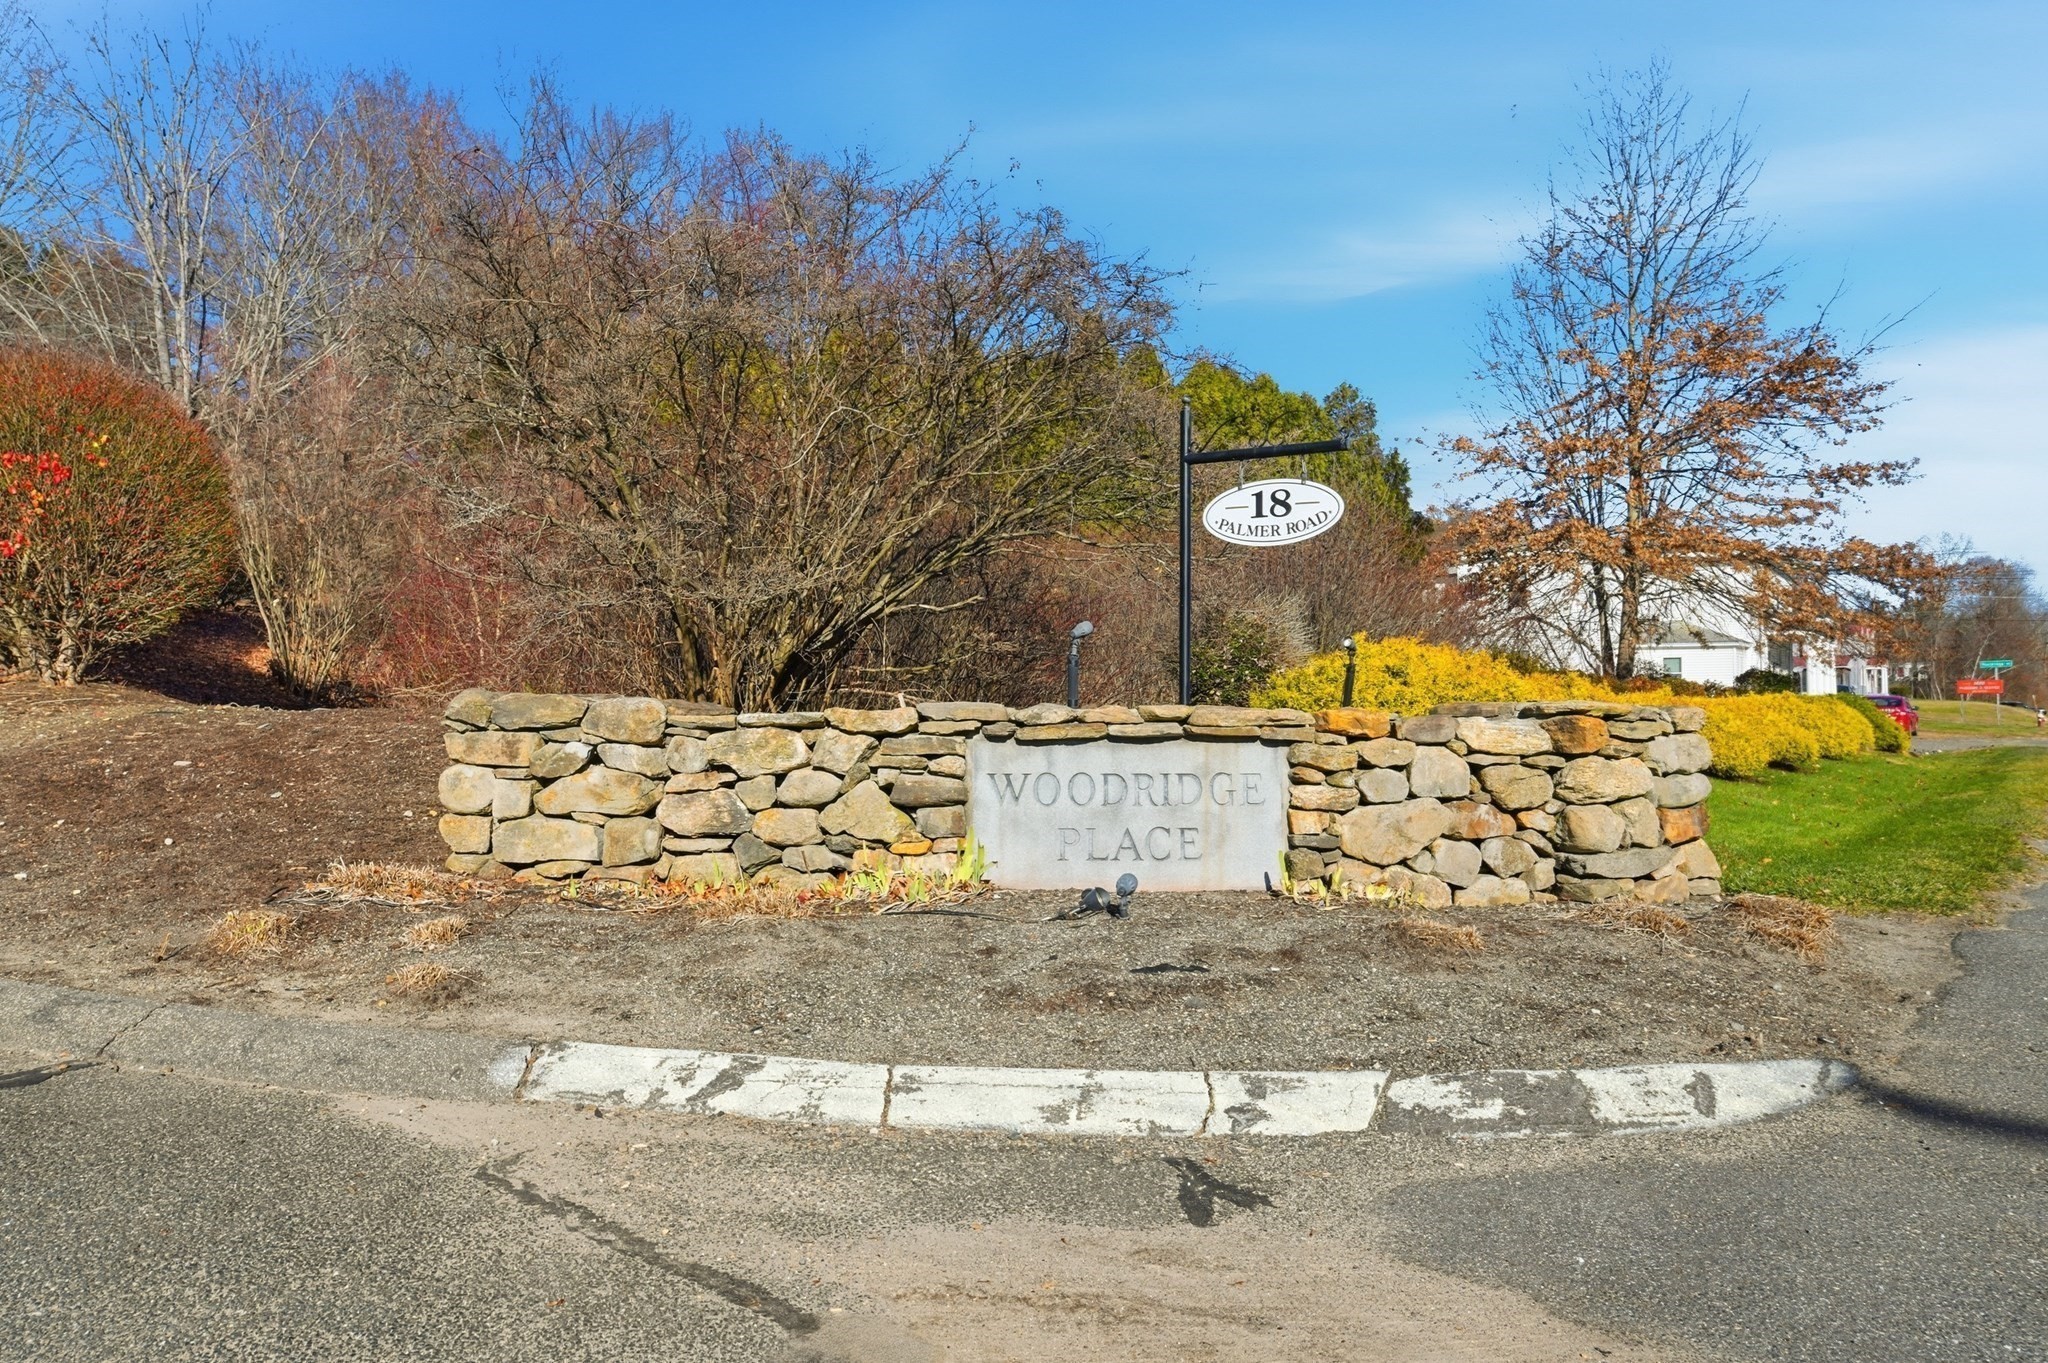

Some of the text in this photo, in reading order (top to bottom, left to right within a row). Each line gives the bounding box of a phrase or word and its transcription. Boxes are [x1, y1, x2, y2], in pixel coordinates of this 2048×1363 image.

[1250, 488, 1292, 518] 18
[1218, 510, 1328, 537] PALMER ROAD
[987, 771, 1265, 806] WOODRIDGE
[1057, 826, 1202, 861] PLACE
